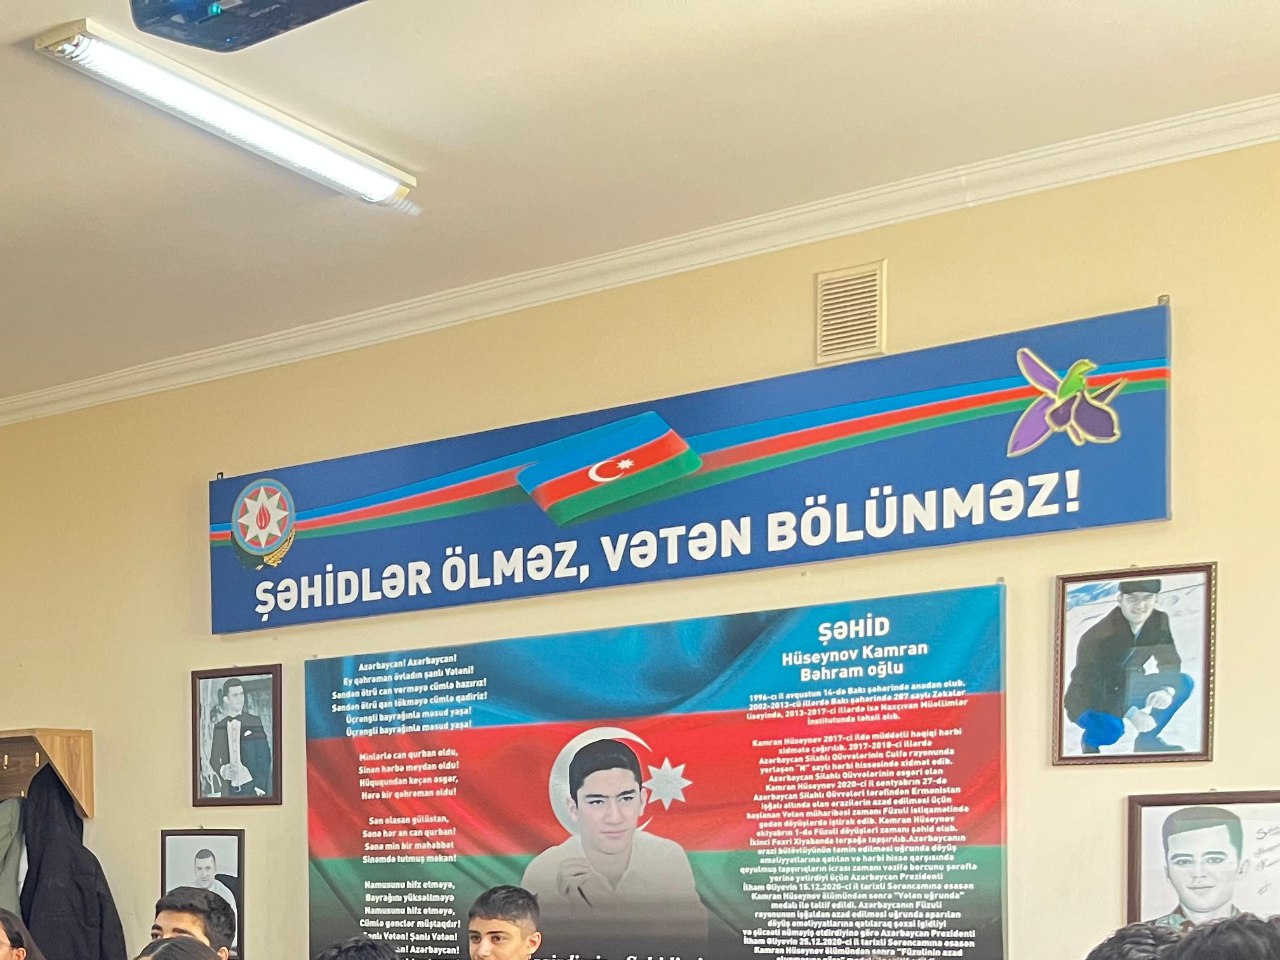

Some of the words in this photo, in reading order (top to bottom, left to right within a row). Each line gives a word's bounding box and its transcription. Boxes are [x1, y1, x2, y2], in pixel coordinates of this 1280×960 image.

[255, 561, 432, 622] ŞƏHİDLƏR
[442, 540, 590, 591] ÖLMƏZ,
[600, 516, 751, 573] VƏTƏN
[767, 468, 1080, 552] BÖLÜNMƏZ!
[818, 612, 890, 646] ŞƏHİD
[782, 649, 858, 667] Hüseynov
[863, 642, 928, 660] Kamran
[800, 666, 863, 682] Bəhram
[867, 661, 904, 680] oğlu
